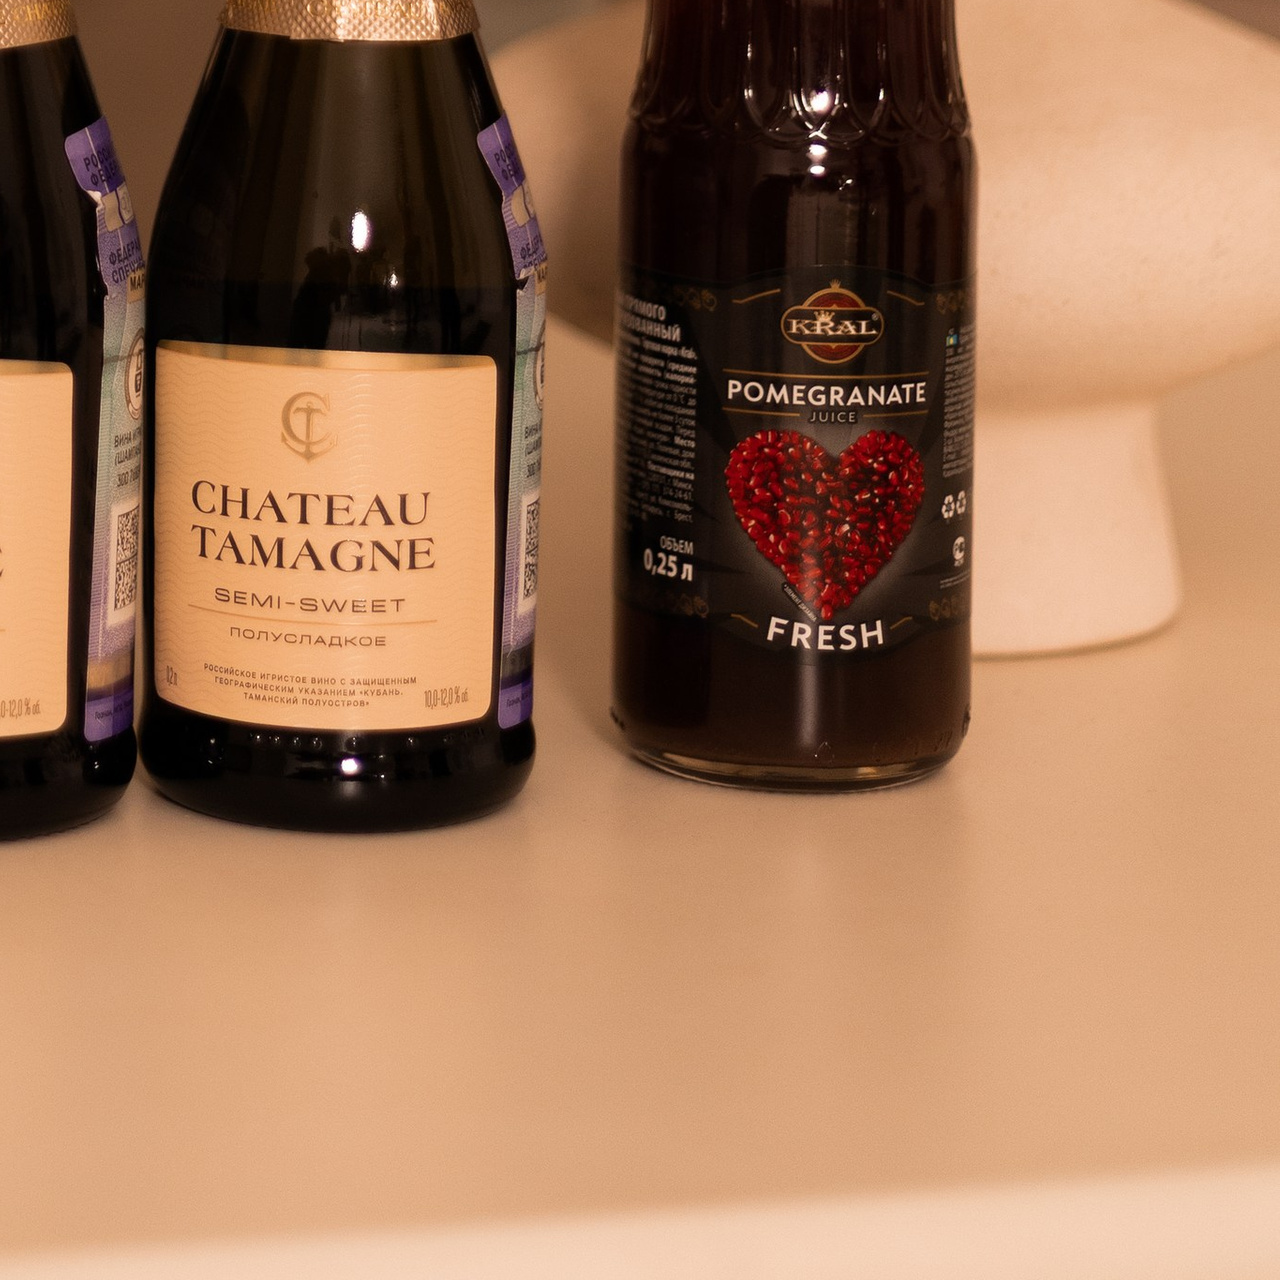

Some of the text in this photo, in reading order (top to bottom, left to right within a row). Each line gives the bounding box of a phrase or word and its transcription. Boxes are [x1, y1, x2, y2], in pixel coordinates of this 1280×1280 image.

[787, 317, 878, 336] KRAL
[727, 379, 927, 406] POMEGRANATE
[810, 411, 857, 422] JUICE
[191, 480, 431, 526] CHATEAU
[191, 524, 435, 572] TAMAGNE
[660, 535, 693, 555] ОБЪЕМ
[643, 548, 693, 581] 0,25 л
[214, 587, 406, 613] SEMI-SWEET
[230, 627, 387, 648] ПОЛУСЛАДКОЕ
[767, 616, 883, 650] FRESH
[204, 663, 257, 679] РОССИЙСКОЕ
[260, 672, 307, 684] ИГРИСТОЕ
[311, 677, 336, 686] ВИНО
[350, 677, 417, 687] ЗАЩИЩЕННЫМ
[214, 676, 294, 693] ГЕОГРАФИЧЕСКИМ
[298, 686, 356, 696] УКАЗАНИЕМ
[244, 692, 298, 705] ТАМАНСКИЙ
